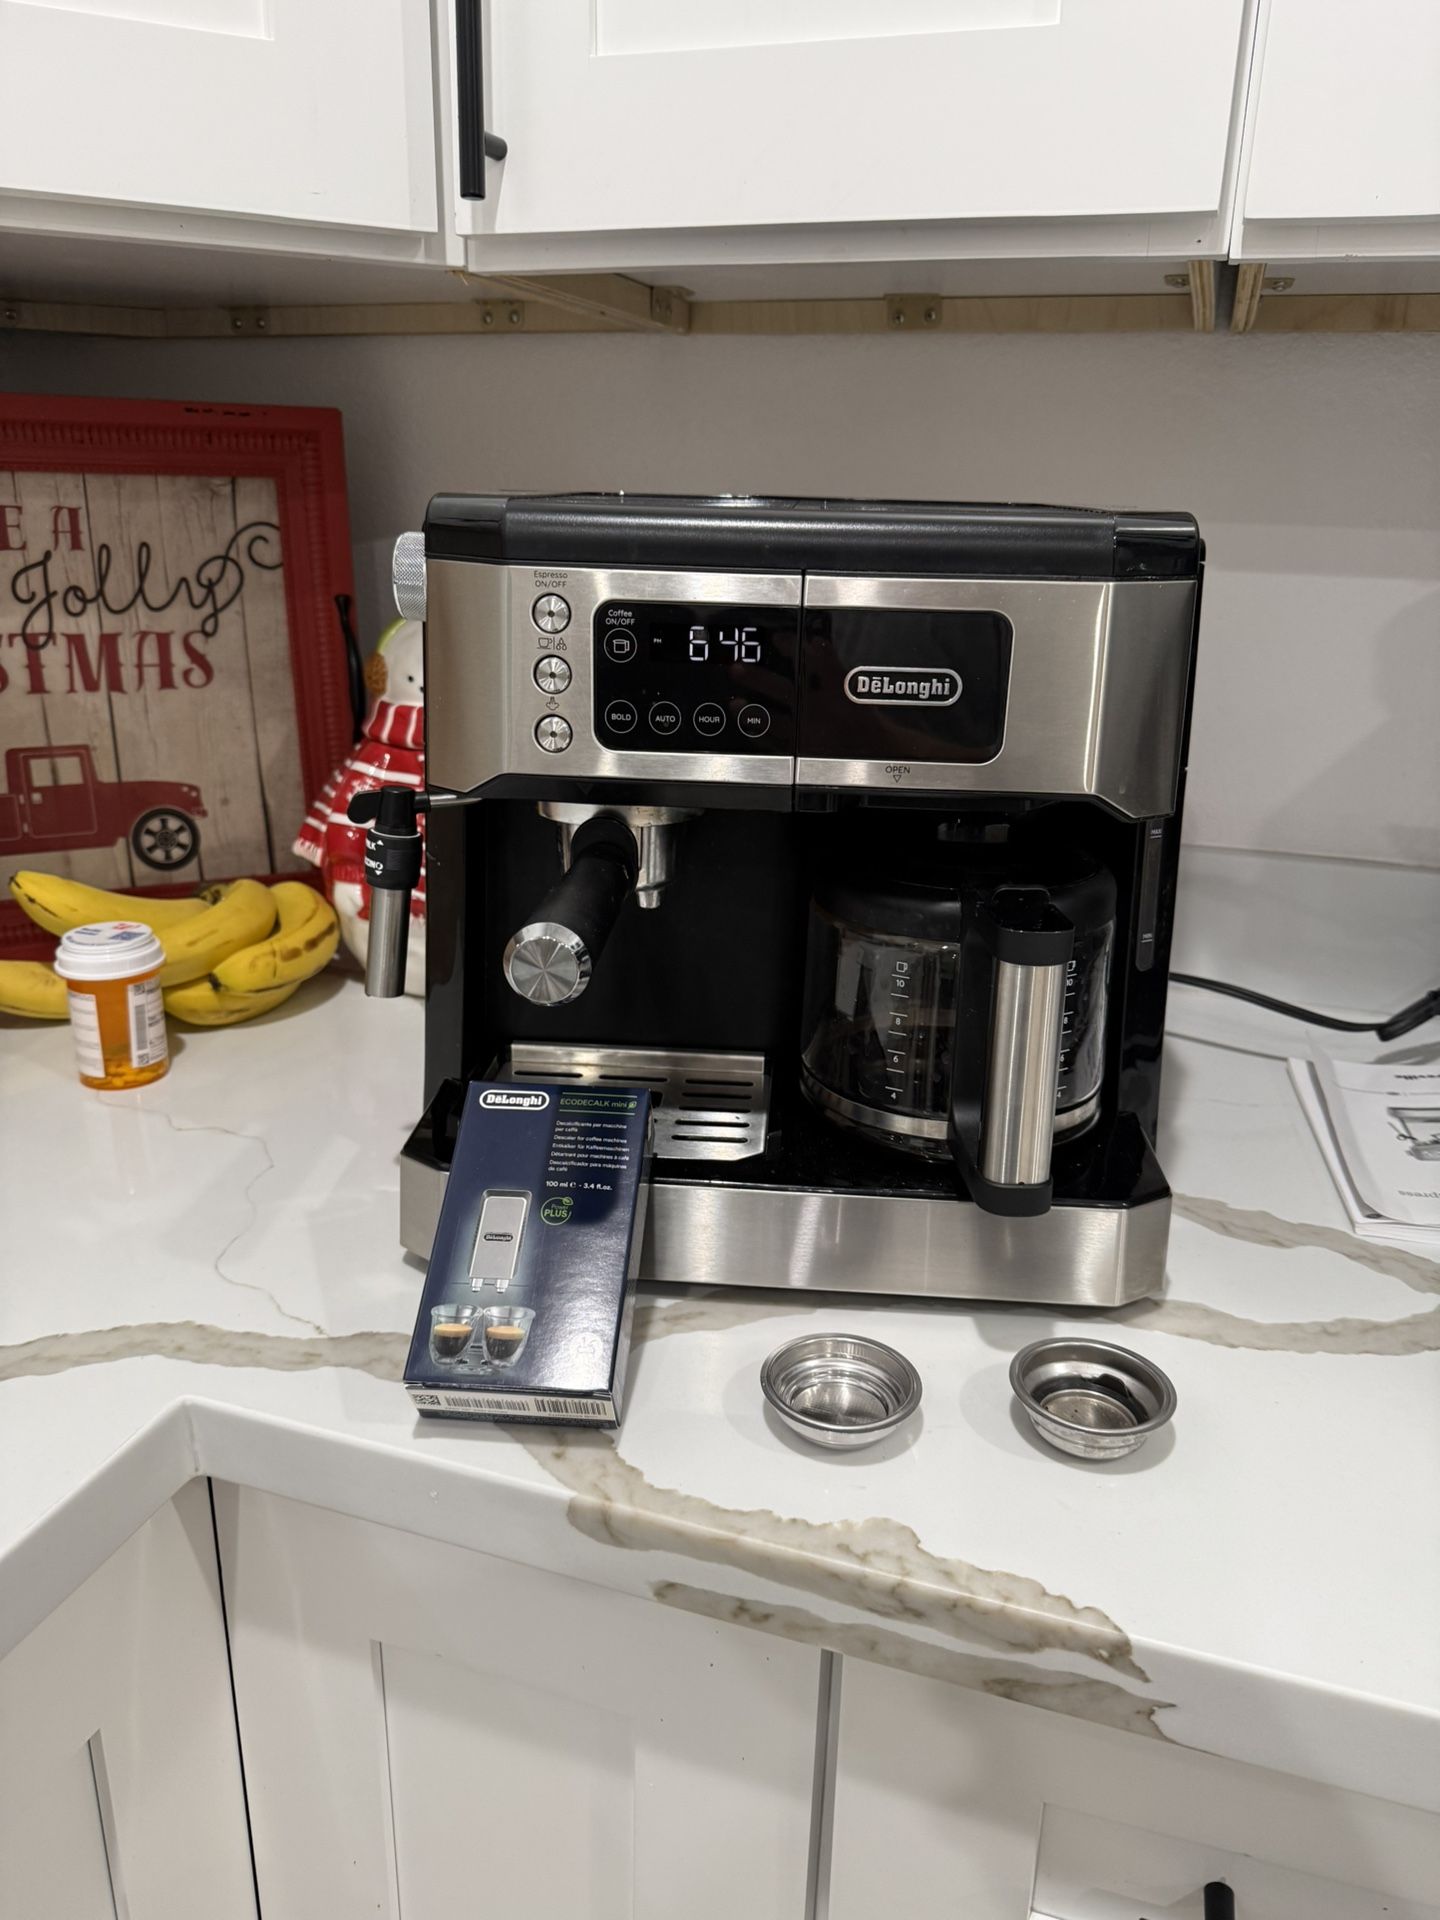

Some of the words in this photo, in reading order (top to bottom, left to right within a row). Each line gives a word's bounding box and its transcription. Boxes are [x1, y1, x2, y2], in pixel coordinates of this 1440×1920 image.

[50, 505, 84, 551] A
[533, 570, 568, 580] Espresso
[11, 521, 285, 650] Jolly
[535, 580, 567, 588] ON/OFF
[607, 609, 633, 617] Coffee
[605, 618, 635, 626] ON/OFF
[0, 629, 215, 695] TMAS
[611, 713, 632, 721] BOLD
[655, 715, 676, 723] AUTO
[698, 716, 720, 724] HOUR
[747, 717, 761, 725] MIN
[885, 765, 911, 774] OPEN
[896, 979, 905, 988] 10
[895, 1017, 901, 1026] 8
[892, 1055, 899, 1063] 6
[890, 1092, 897, 1100] 4
[560, 1098, 610, 1107] ECODECALK
[583, 1182, 595, 1190] 3.4
[543, 1208, 568, 1218] PLUS
